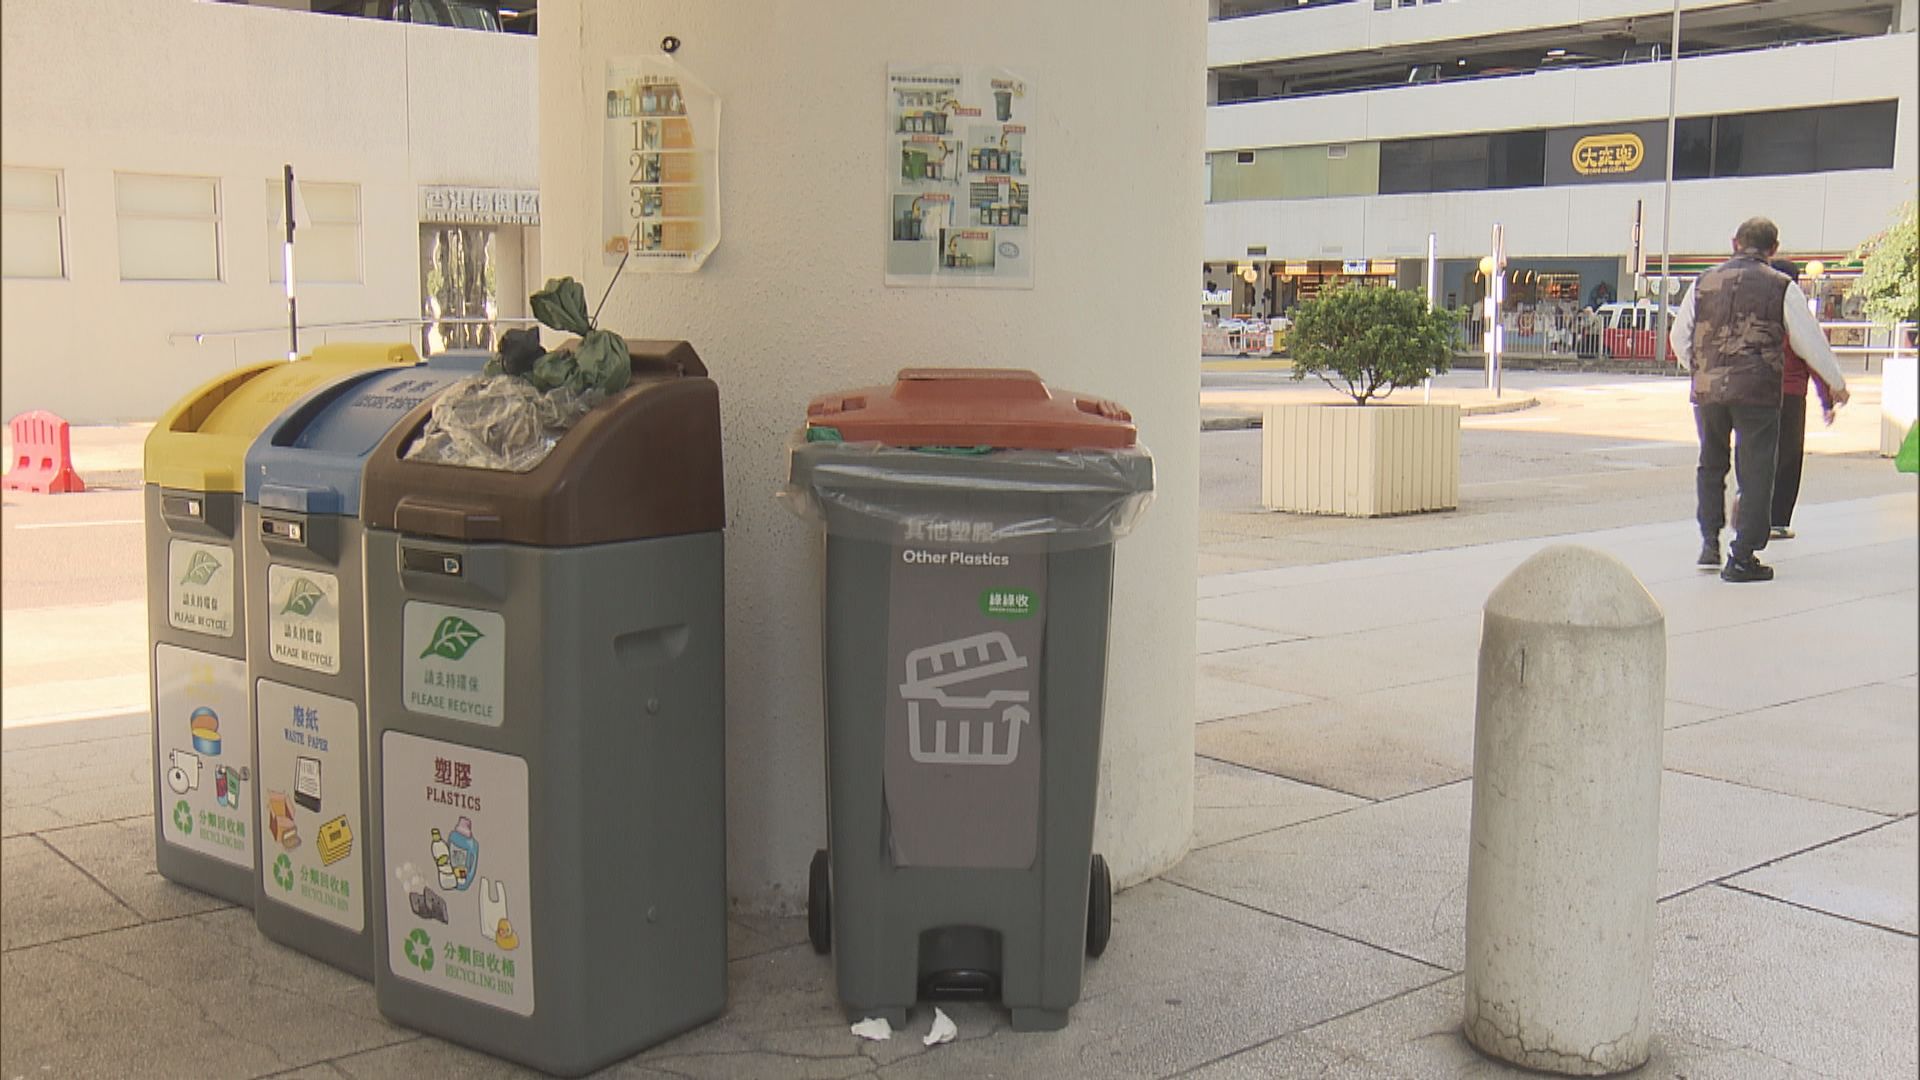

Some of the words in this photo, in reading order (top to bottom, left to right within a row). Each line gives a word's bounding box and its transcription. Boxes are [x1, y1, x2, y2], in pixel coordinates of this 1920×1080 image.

[903, 550, 947, 564] Other
[950, 551, 1009, 566] Plastics
[174, 610, 196, 624] PLEASE
[198, 616, 227, 631] RECYCLE
[275, 643, 299, 659] PLEASE
[301, 649, 333, 667] RECYCLE
[424, 669, 480, 693] 請支持環保
[411, 691, 444, 709] PLEASE
[448, 699, 493, 718] RECYCLE
[292, 704, 319, 733] 廢紙
[435, 756, 472, 789] 塑膠
[426, 786, 481, 812] PLASTICS
[443, 941, 516, 979] 分類回收桶
[445, 964, 496, 990] RECYCLING
[498, 980, 515, 997] BIN
